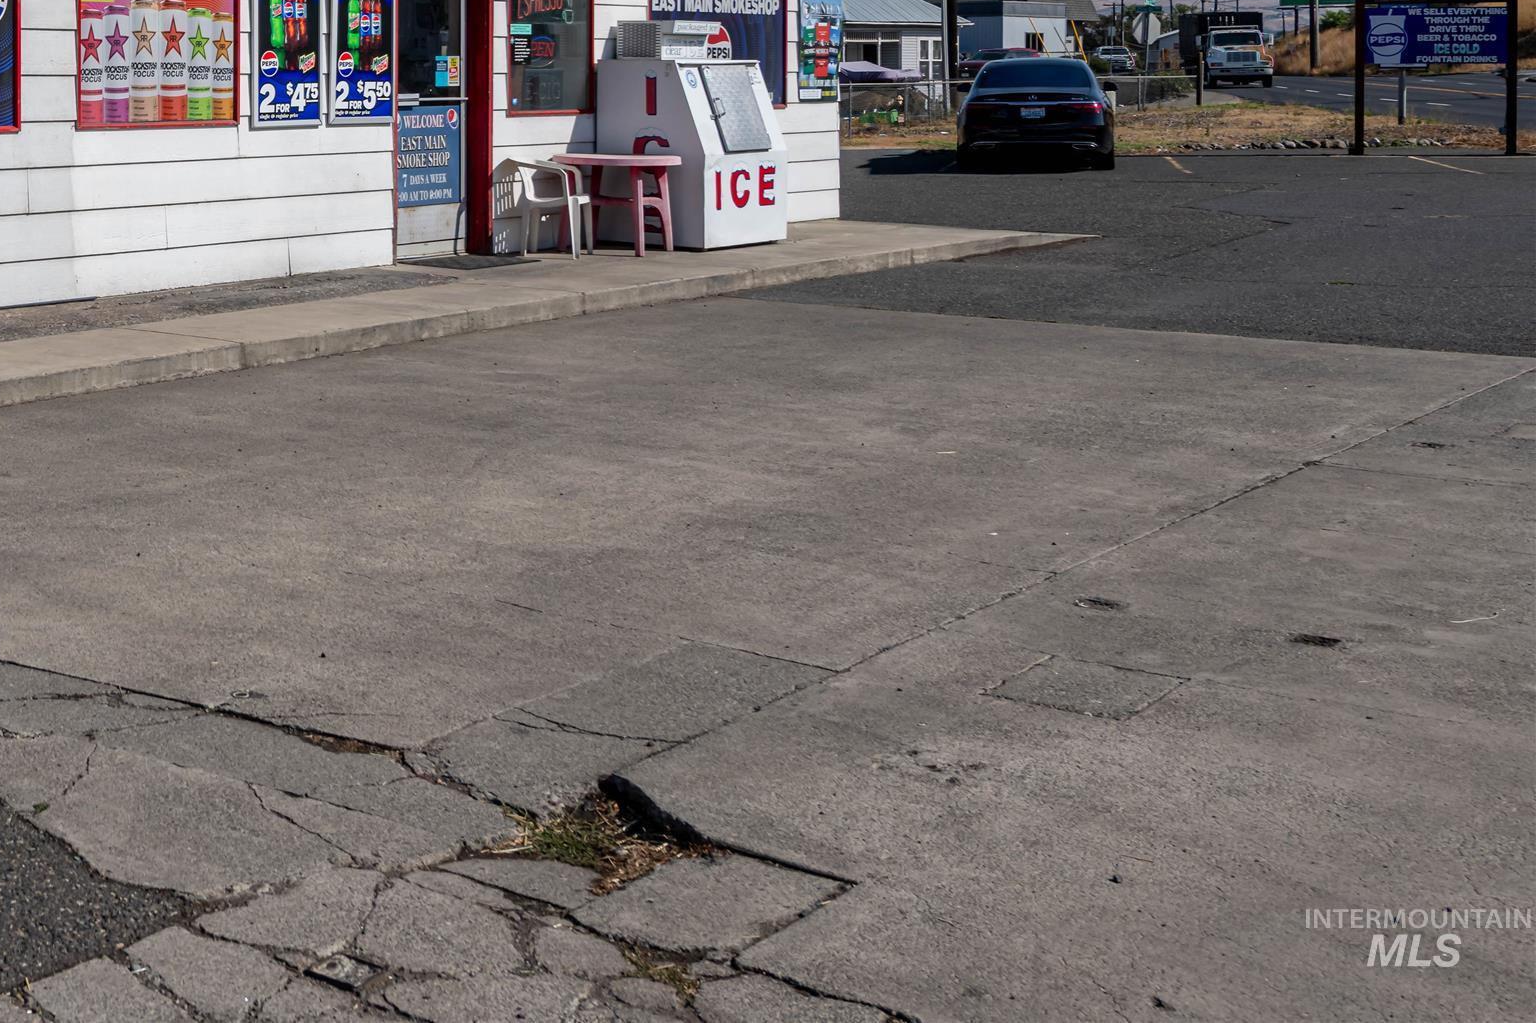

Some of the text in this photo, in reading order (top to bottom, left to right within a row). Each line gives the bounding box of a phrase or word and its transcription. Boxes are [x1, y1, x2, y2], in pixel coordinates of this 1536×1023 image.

[1429, 25, 1457, 33] DRIVE
[1370, 36, 1405, 44] PEPSI
[531, 42, 555, 56] PEN
[707, 47, 730, 59] PEPSI
[1434, 43, 1480, 54] ICE COLD
[259, 83, 276, 113] 2
[276, 104, 290, 113] FOR
[335, 81, 350, 109] 2
[349, 101, 362, 110] FOR
[403, 114, 444, 129] WELCOME
[400, 135, 447, 151] EAST MAIN
[397, 152, 450, 168] SMOKE SHOP
[402, 173, 447, 187] 7 DAYS A WEEK
[715, 160, 777, 210] ICE
[408, 191, 419, 201] AM
[420, 190, 429, 200] TO
[443, 188, 452, 199] PM
